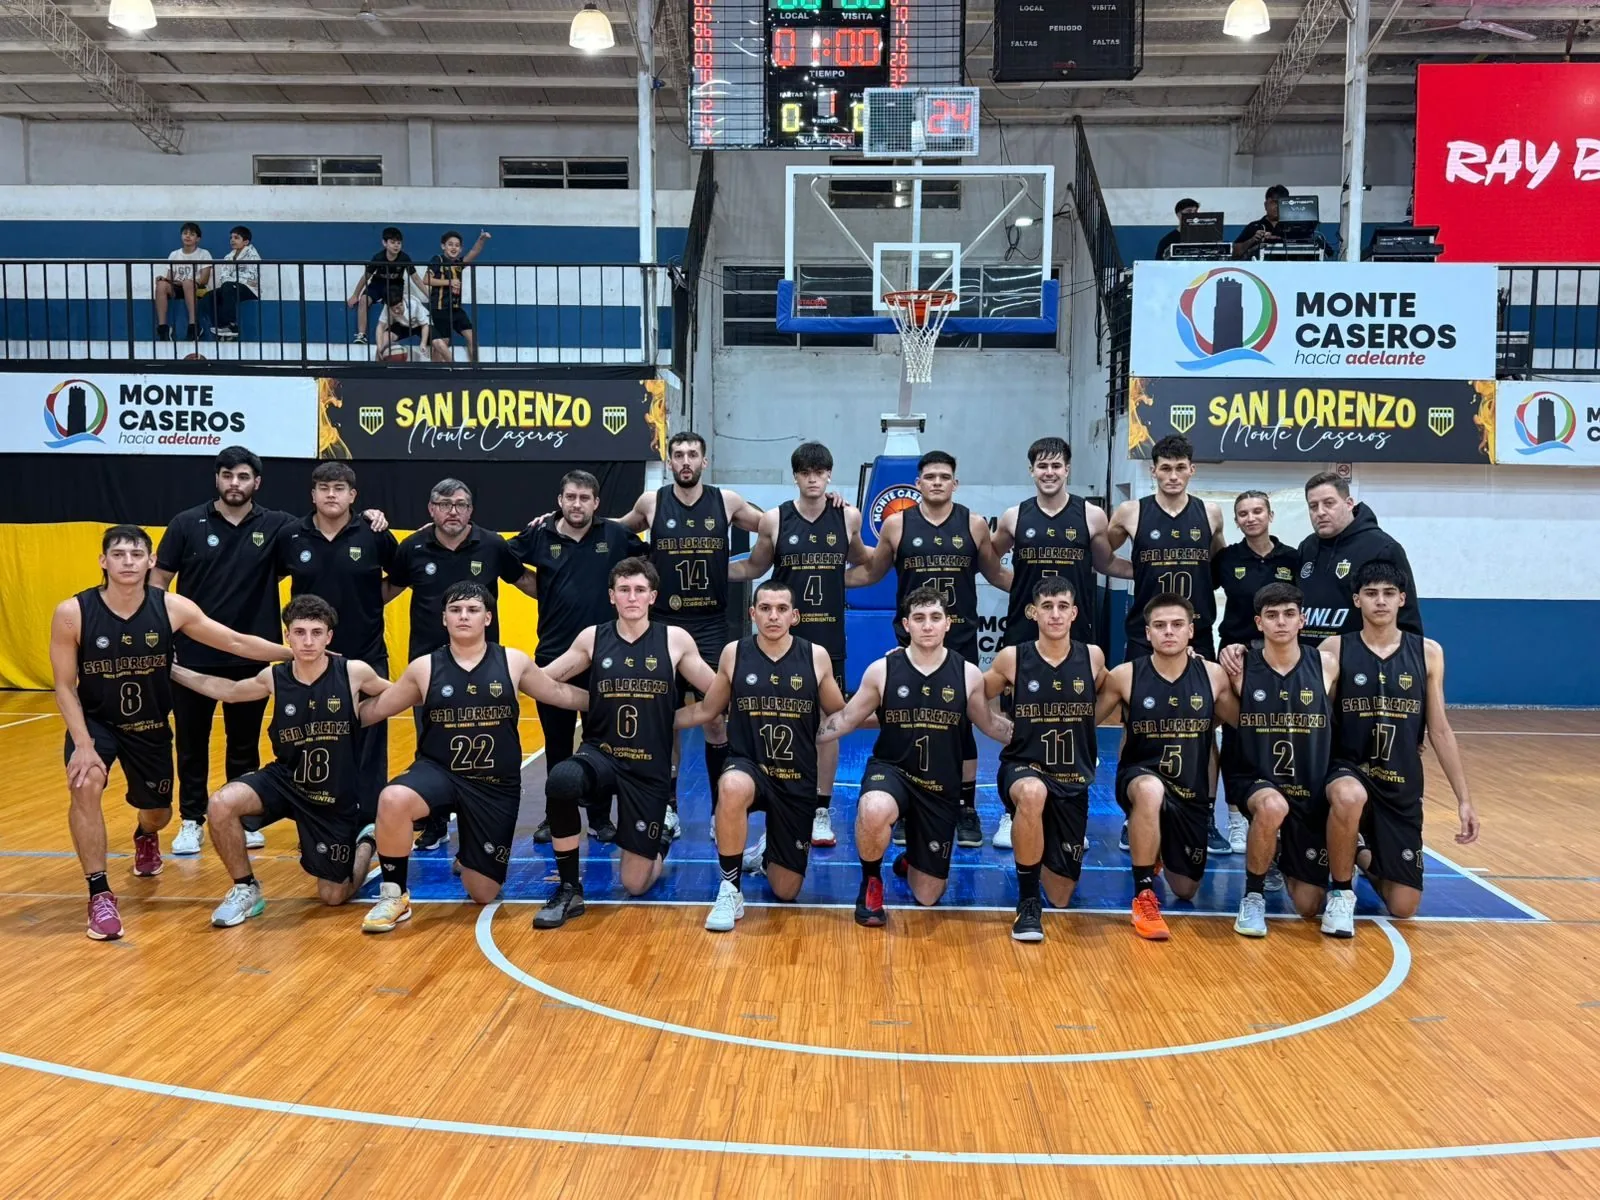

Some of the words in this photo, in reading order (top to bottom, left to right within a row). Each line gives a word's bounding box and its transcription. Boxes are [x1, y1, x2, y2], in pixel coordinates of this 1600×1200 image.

[928, 100, 972, 134] 24
[1446, 138, 1560, 190] RAY
[1296, 292, 1416, 318] MONTE
[1295, 323, 1457, 350] CASEROS
[1294, 350, 1341, 366] hacia
[1345, 350, 1426, 366] adelante
[119, 384, 214, 406] MONTE
[395, 391, 453, 428] SAN
[461, 388, 592, 428] LORENZO
[1208, 389, 1268, 427] SAN
[1277, 388, 1416, 429] LORENZO
[119, 410, 246, 432] CASEROS
[118, 432, 154, 445] hacia
[158, 432, 222, 446] adelante
[408, 416, 476, 454] Monte
[480, 416, 569, 452] Caseros
[1220, 420, 1292, 454] Monte
[1297, 417, 1392, 452] Caseros
[874, 491, 896, 522] MONTE
[897, 490, 923, 504] CASE
[656, 538, 677, 550] SAN
[675, 560, 709, 591] 14
[1158, 571, 1192, 600] 10
[804, 576, 822, 606] 4
[83, 660, 112, 674] SAN
[120, 682, 142, 716] 8
[615, 678, 668, 694] LORENZO
[430, 708, 454, 722] SAN
[737, 696, 759, 711] SAN
[761, 696, 814, 714] LORENZO
[885, 709, 910, 723] SAN
[1016, 704, 1040, 718] SAN
[1341, 698, 1370, 712] SAN
[617, 704, 638, 738] 6
[1132, 720, 1158, 734] SAN
[1240, 712, 1267, 727] SAN
[1270, 712, 1326, 728] LORENZO
[278, 726, 304, 744] SAN
[760, 724, 794, 760] 12
[1041, 728, 1074, 766] 11
[1370, 722, 1396, 761] 17
[293, 747, 330, 784] 18
[450, 734, 495, 770] 22
[915, 735, 930, 772] 1
[1160, 744, 1182, 778] 5
[1272, 740, 1295, 777] 2
[158, 778, 171, 794] 8
[648, 822, 660, 840] 6
[330, 844, 350, 864] 18
[1318, 848, 1329, 867] 2
